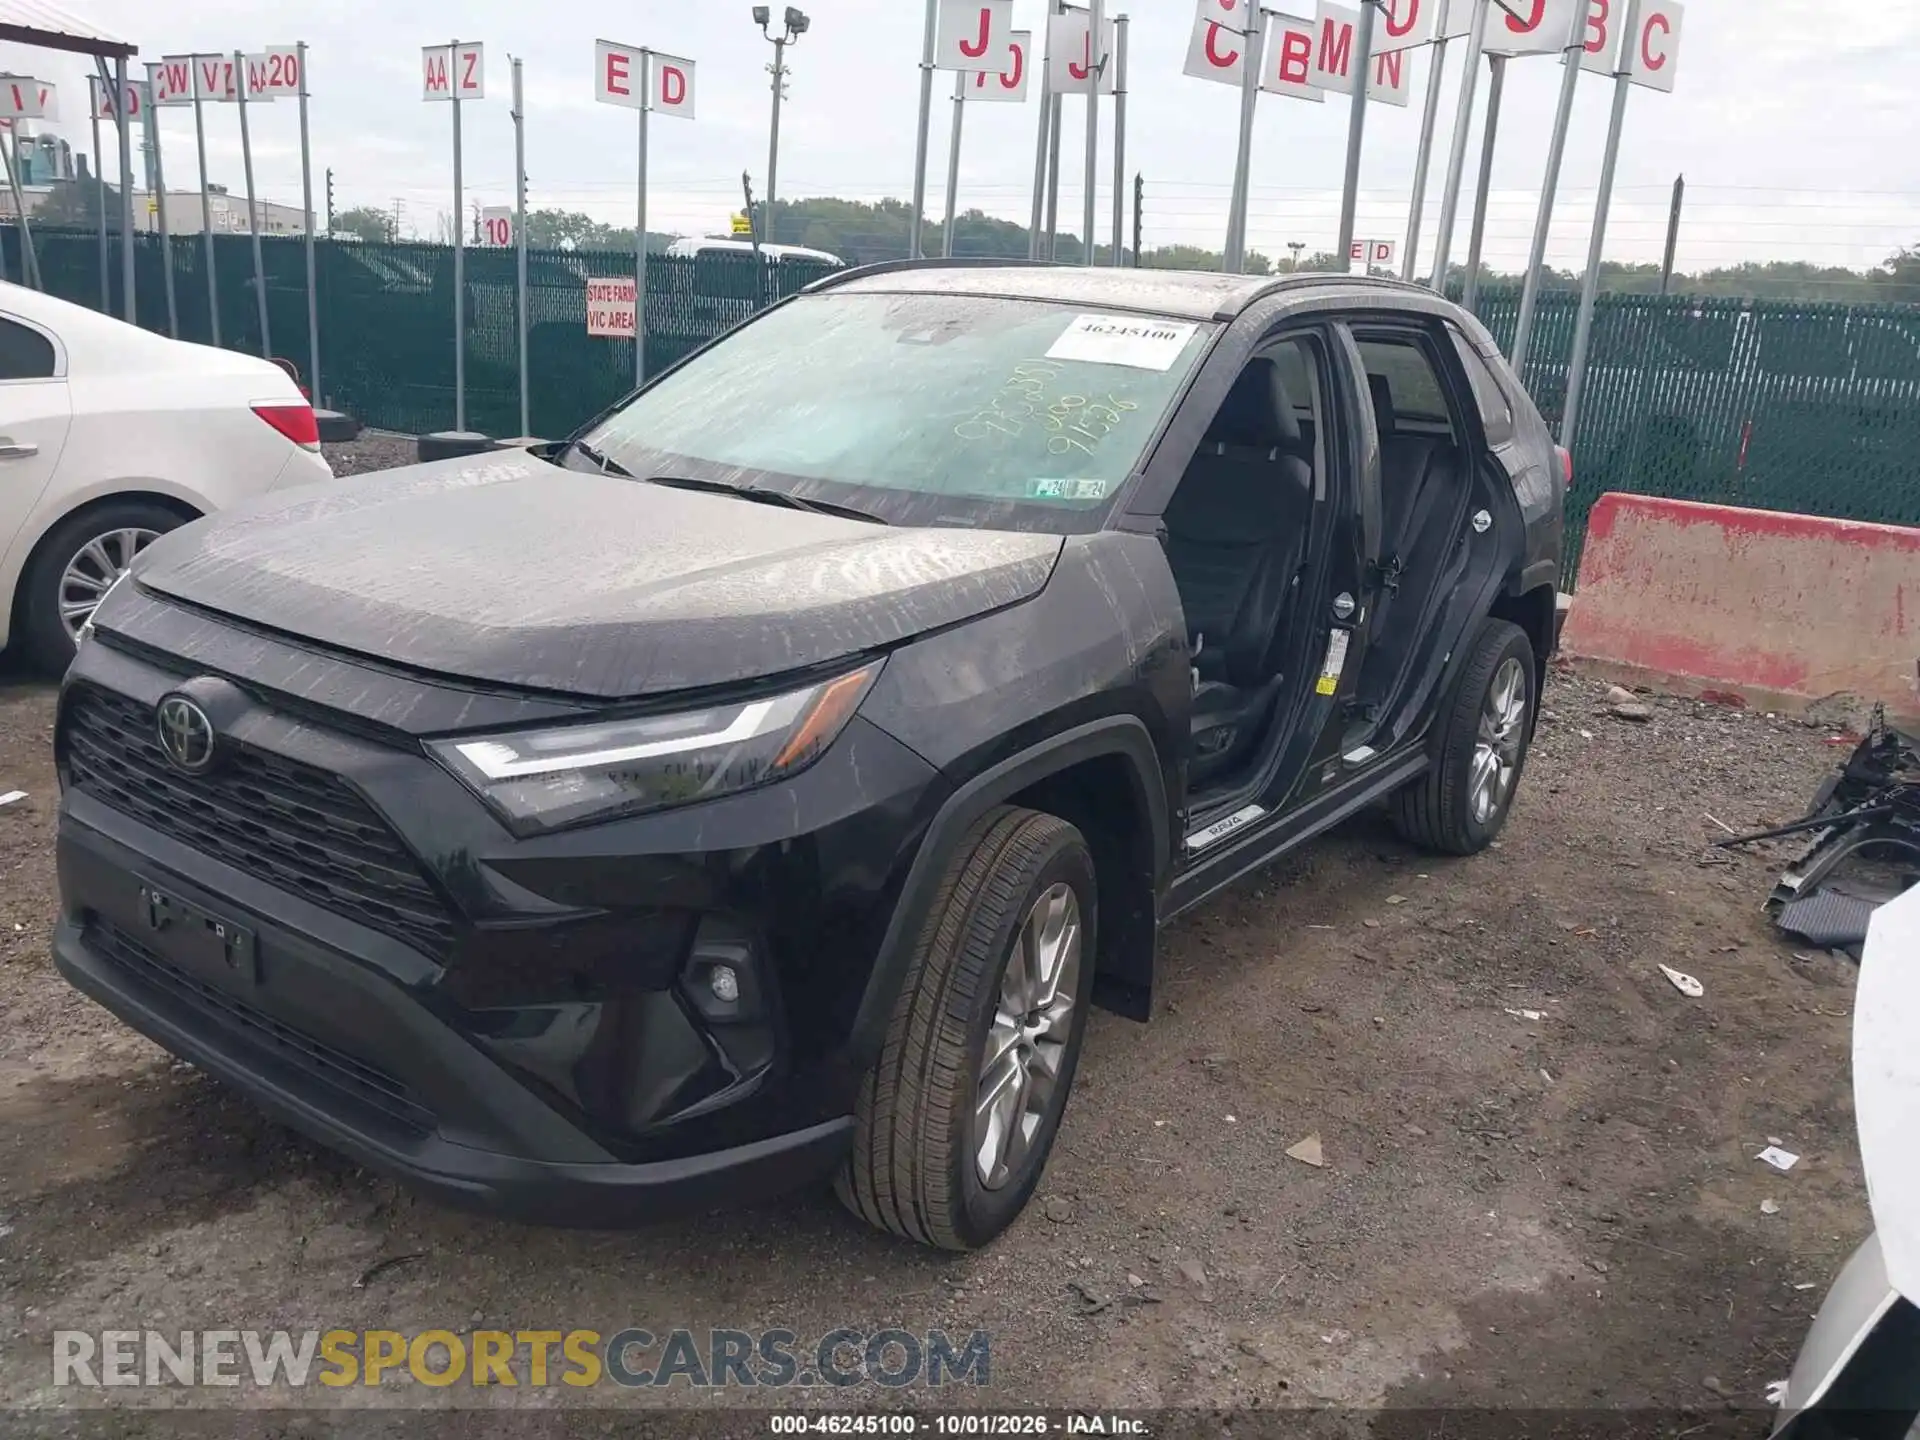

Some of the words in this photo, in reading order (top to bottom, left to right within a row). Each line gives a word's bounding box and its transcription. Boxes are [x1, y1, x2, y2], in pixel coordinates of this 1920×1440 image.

[959, 8, 991, 58] J
[1318, 17, 1353, 77] M
[1642, 13, 1670, 71] C
[269, 54, 298, 87] 20
[426, 56, 448, 91] AA
[463, 53, 477, 89] Z
[1279, 31, 1312, 84] B
[166, 63, 187, 94] W
[202, 62, 218, 93] V
[607, 54, 630, 95] E
[662, 65, 686, 105] D
[487, 218, 508, 245] 10
[1351, 243, 1363, 258] E
[1377, 244, 1389, 259] D
[588, 285, 612, 302] STATE
[614, 285, 635, 302] FARM
[589, 311, 606, 328] VIC
[608, 311, 634, 329] AREA
[1080, 323, 1177, 341] 46245100
